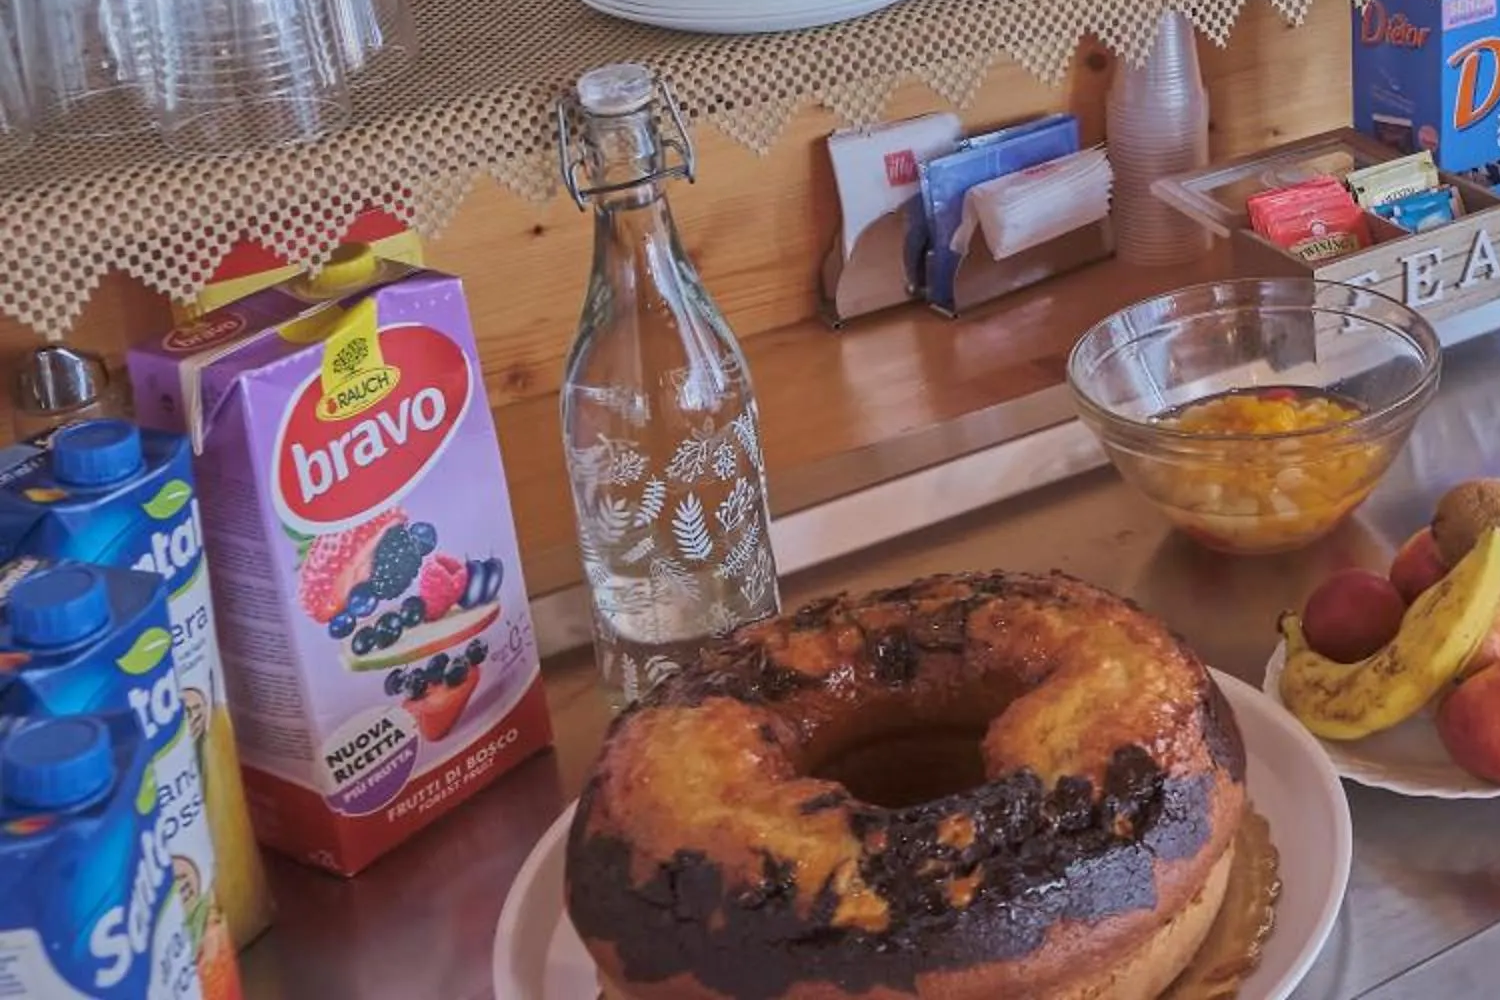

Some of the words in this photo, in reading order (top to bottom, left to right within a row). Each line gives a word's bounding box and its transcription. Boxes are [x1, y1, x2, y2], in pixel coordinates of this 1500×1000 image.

[337, 371, 390, 409] RAUCH
[291, 387, 447, 504] bravo
[325, 717, 394, 769] NUOVA
[333, 728, 406, 785] RICETTA
[368, 748, 414, 788] FRUTTA
[386, 780, 440, 823] FRUTTI
[445, 766, 463, 784] DI
[466, 728, 519, 770] BOSCO
[418, 779, 461, 814] FOREST
[462, 757, 495, 785] FRUIT
